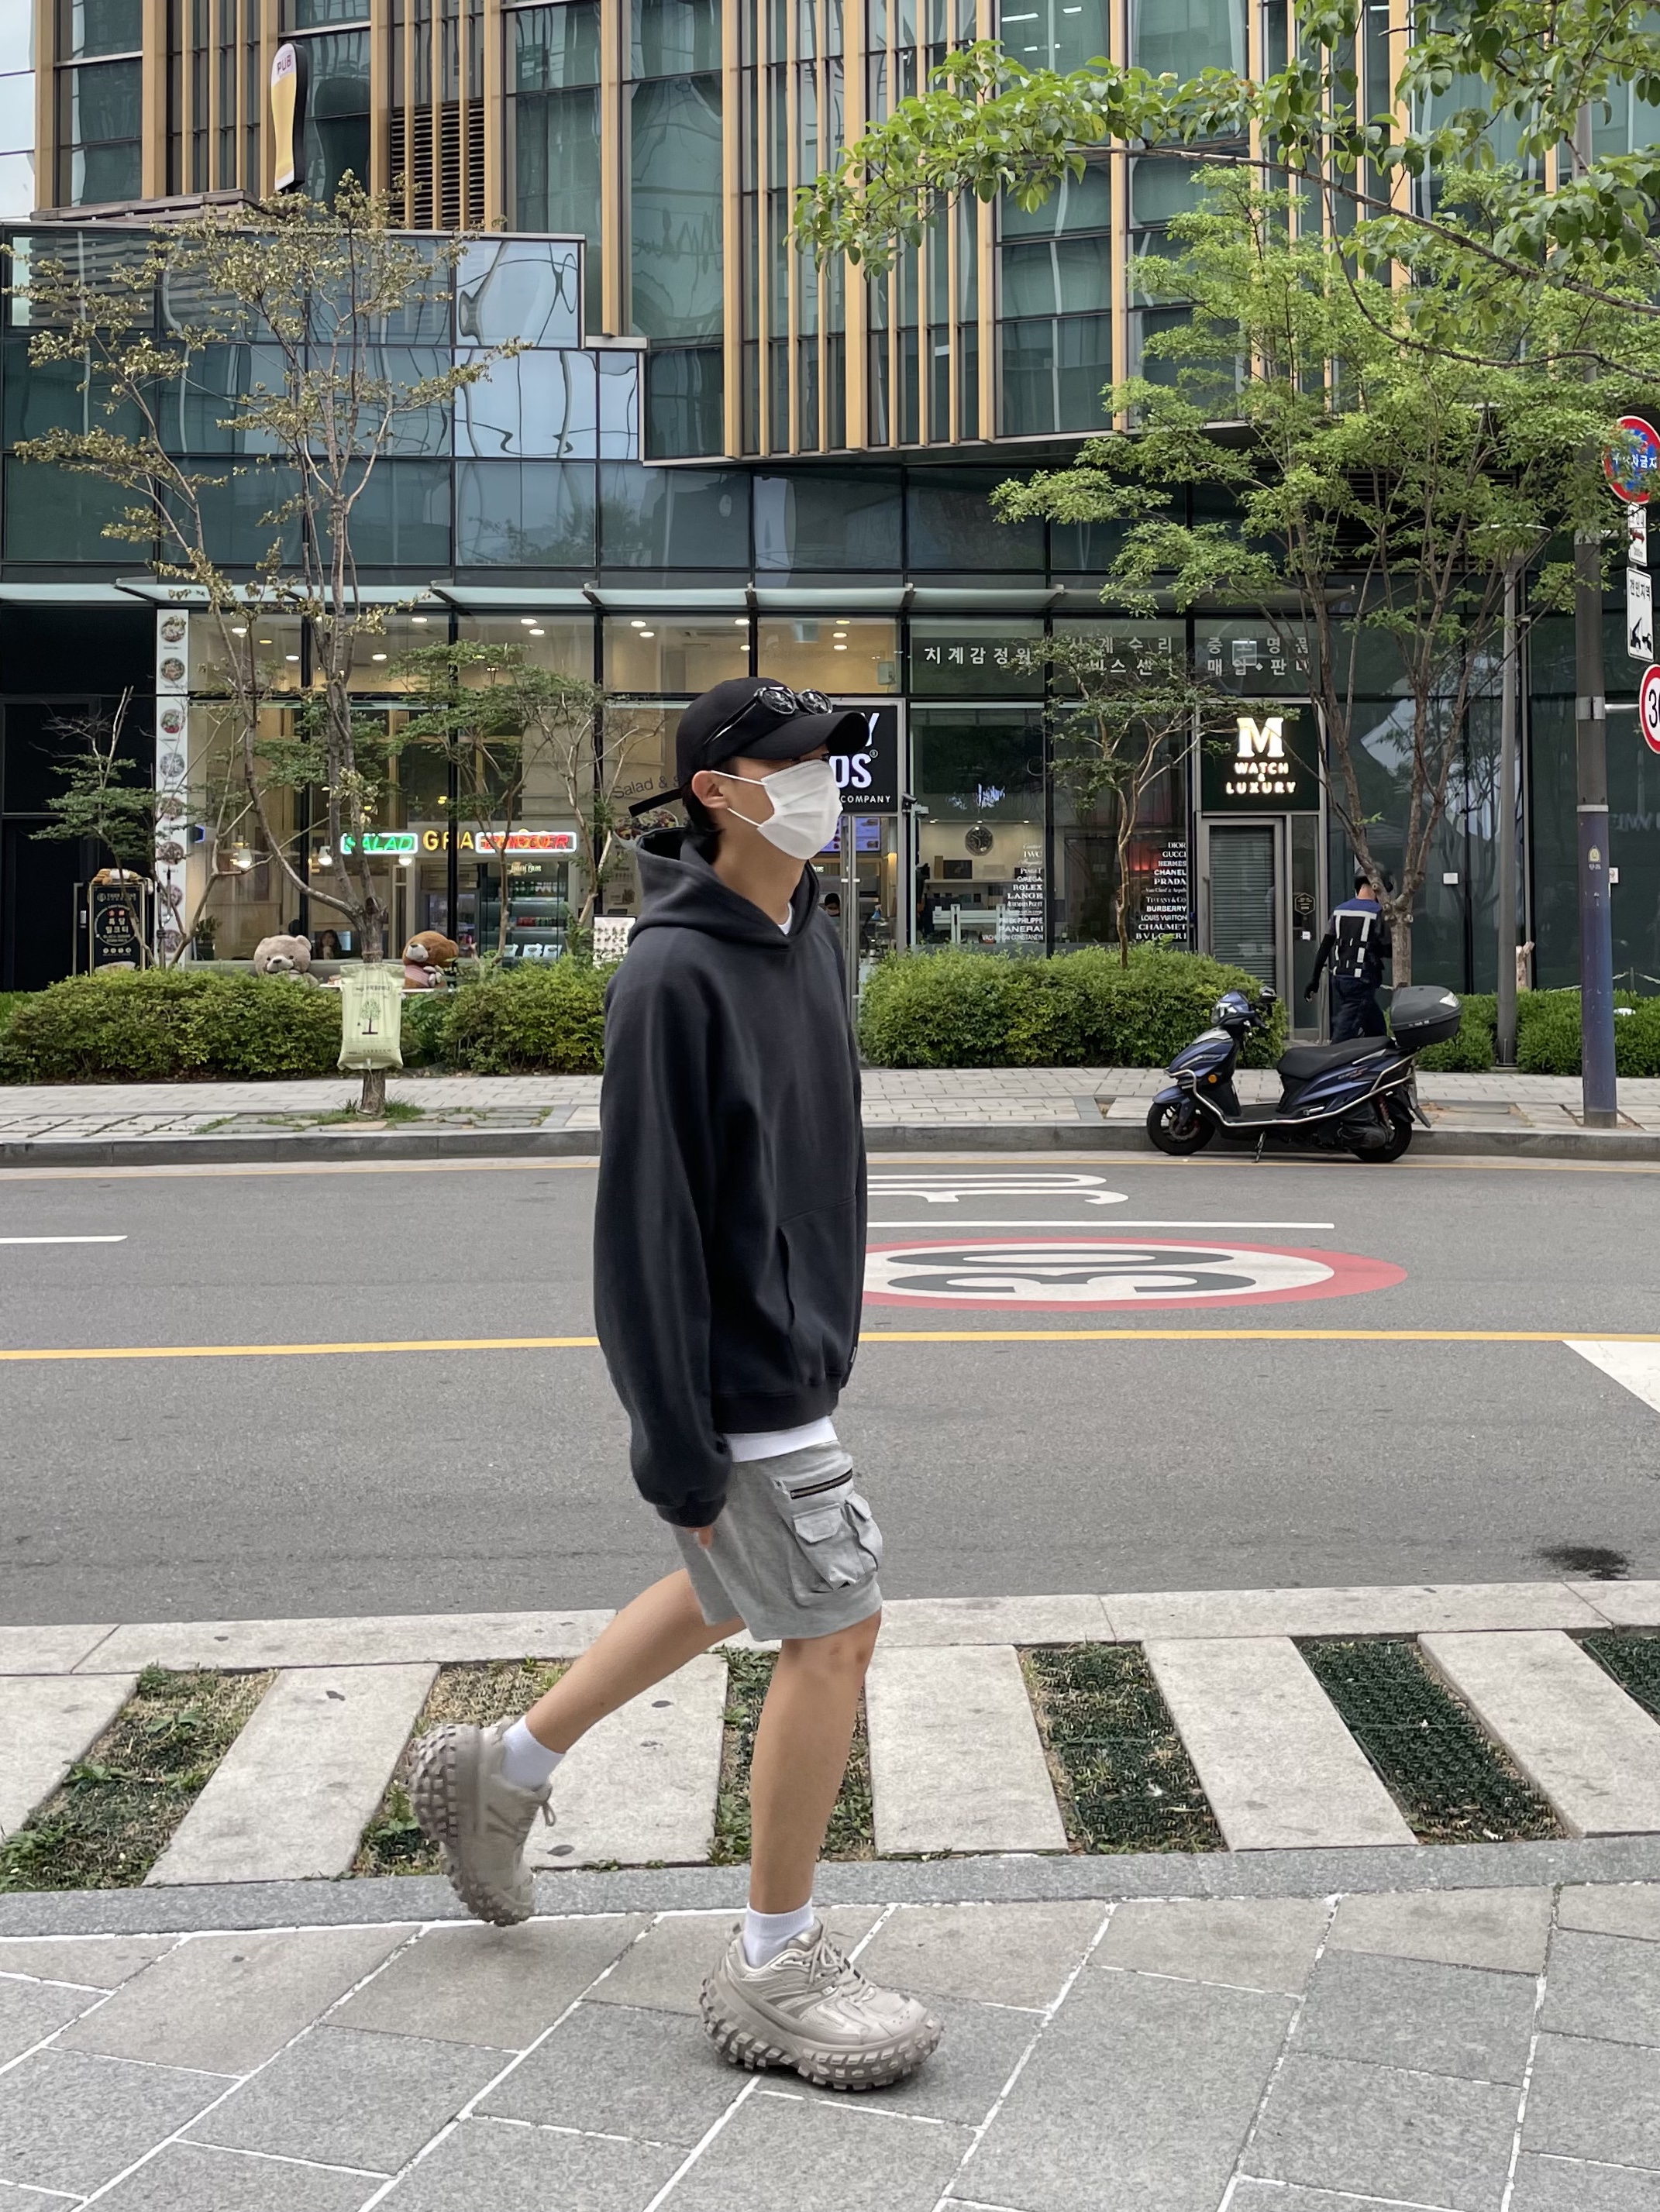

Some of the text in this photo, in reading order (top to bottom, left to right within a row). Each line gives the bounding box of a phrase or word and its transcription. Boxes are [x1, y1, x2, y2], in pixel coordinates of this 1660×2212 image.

[277, 55, 291, 75] PUB
[1649, 689, 1660, 728] 3
[1236, 717, 1285, 757] M
[1235, 762, 1290, 775] WATCH
[612, 777, 653, 799] Salad
[1226, 782, 1297, 795] LUXURY
[840, 795, 891, 803] COMPANY
[1135, 932, 1186, 941] BVLGRI
[887, 1249, 1257, 1294] 30
